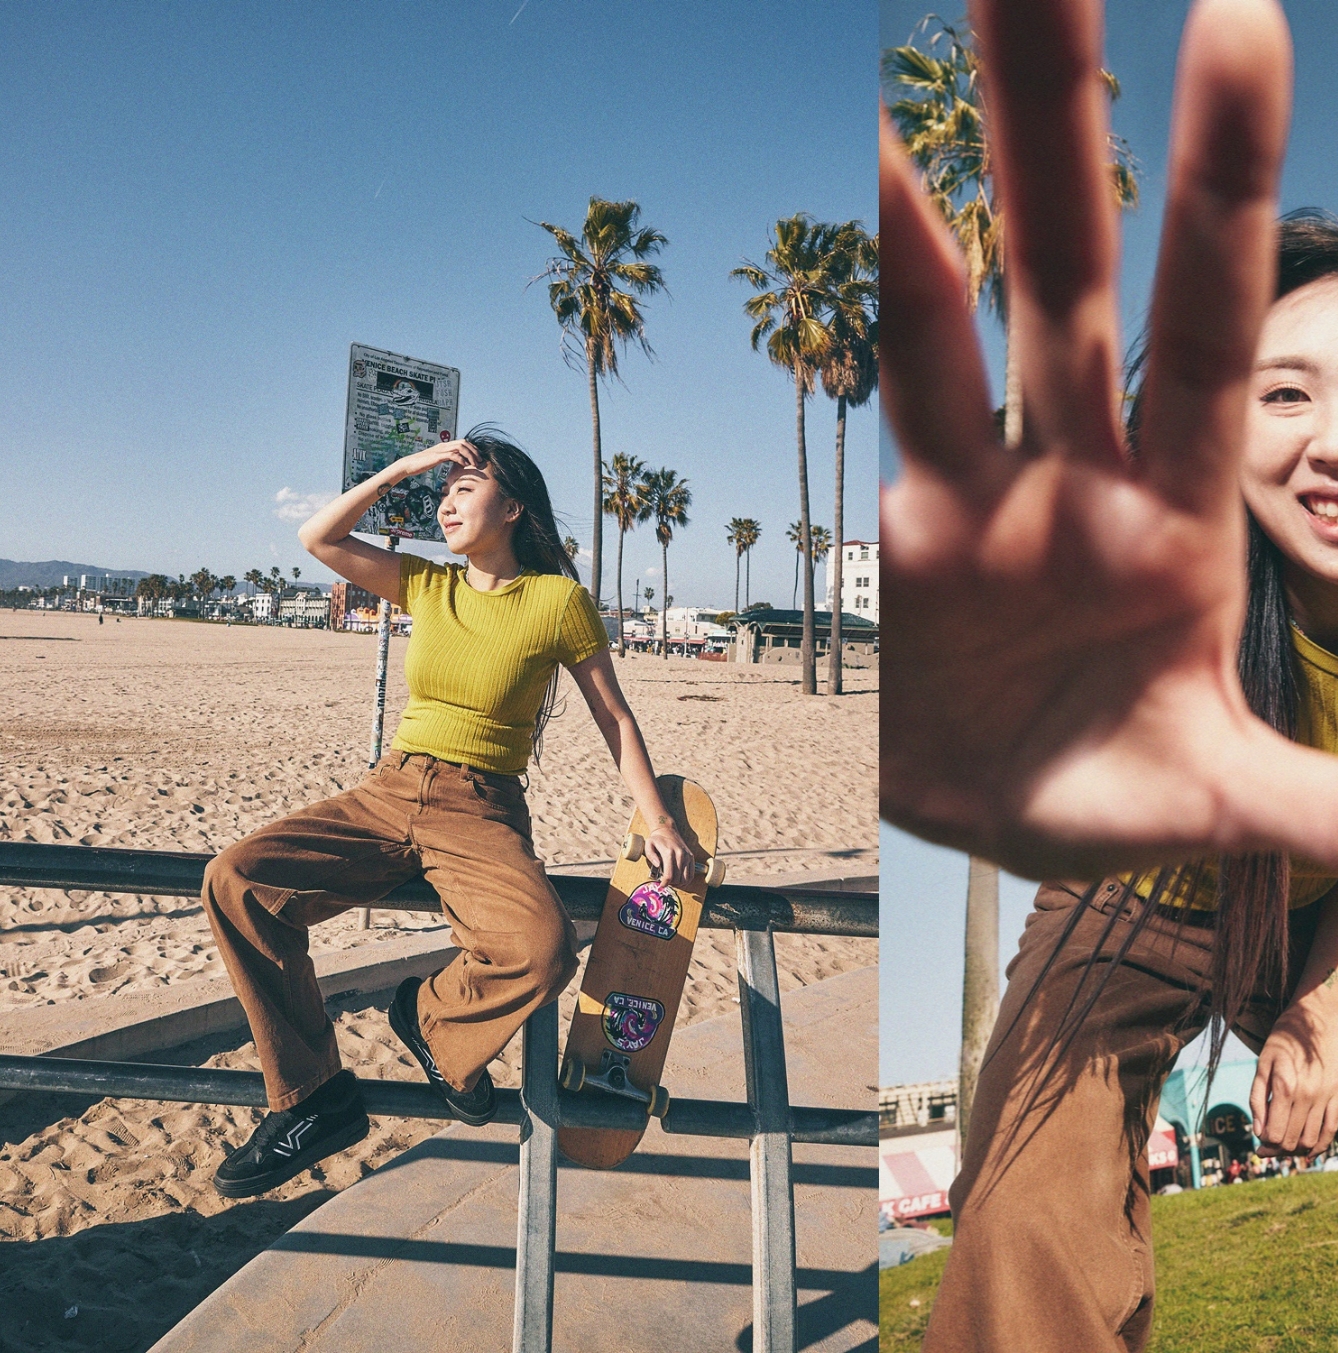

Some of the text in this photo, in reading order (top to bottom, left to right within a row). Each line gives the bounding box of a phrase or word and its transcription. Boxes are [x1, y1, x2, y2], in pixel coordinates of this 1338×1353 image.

[387, 365, 408, 376] BEACH
[409, 370, 428, 381] SKATE
[657, 926, 669, 937] CA
[613, 995, 625, 1006] CA
[898, 1192, 942, 1214] CAFE
